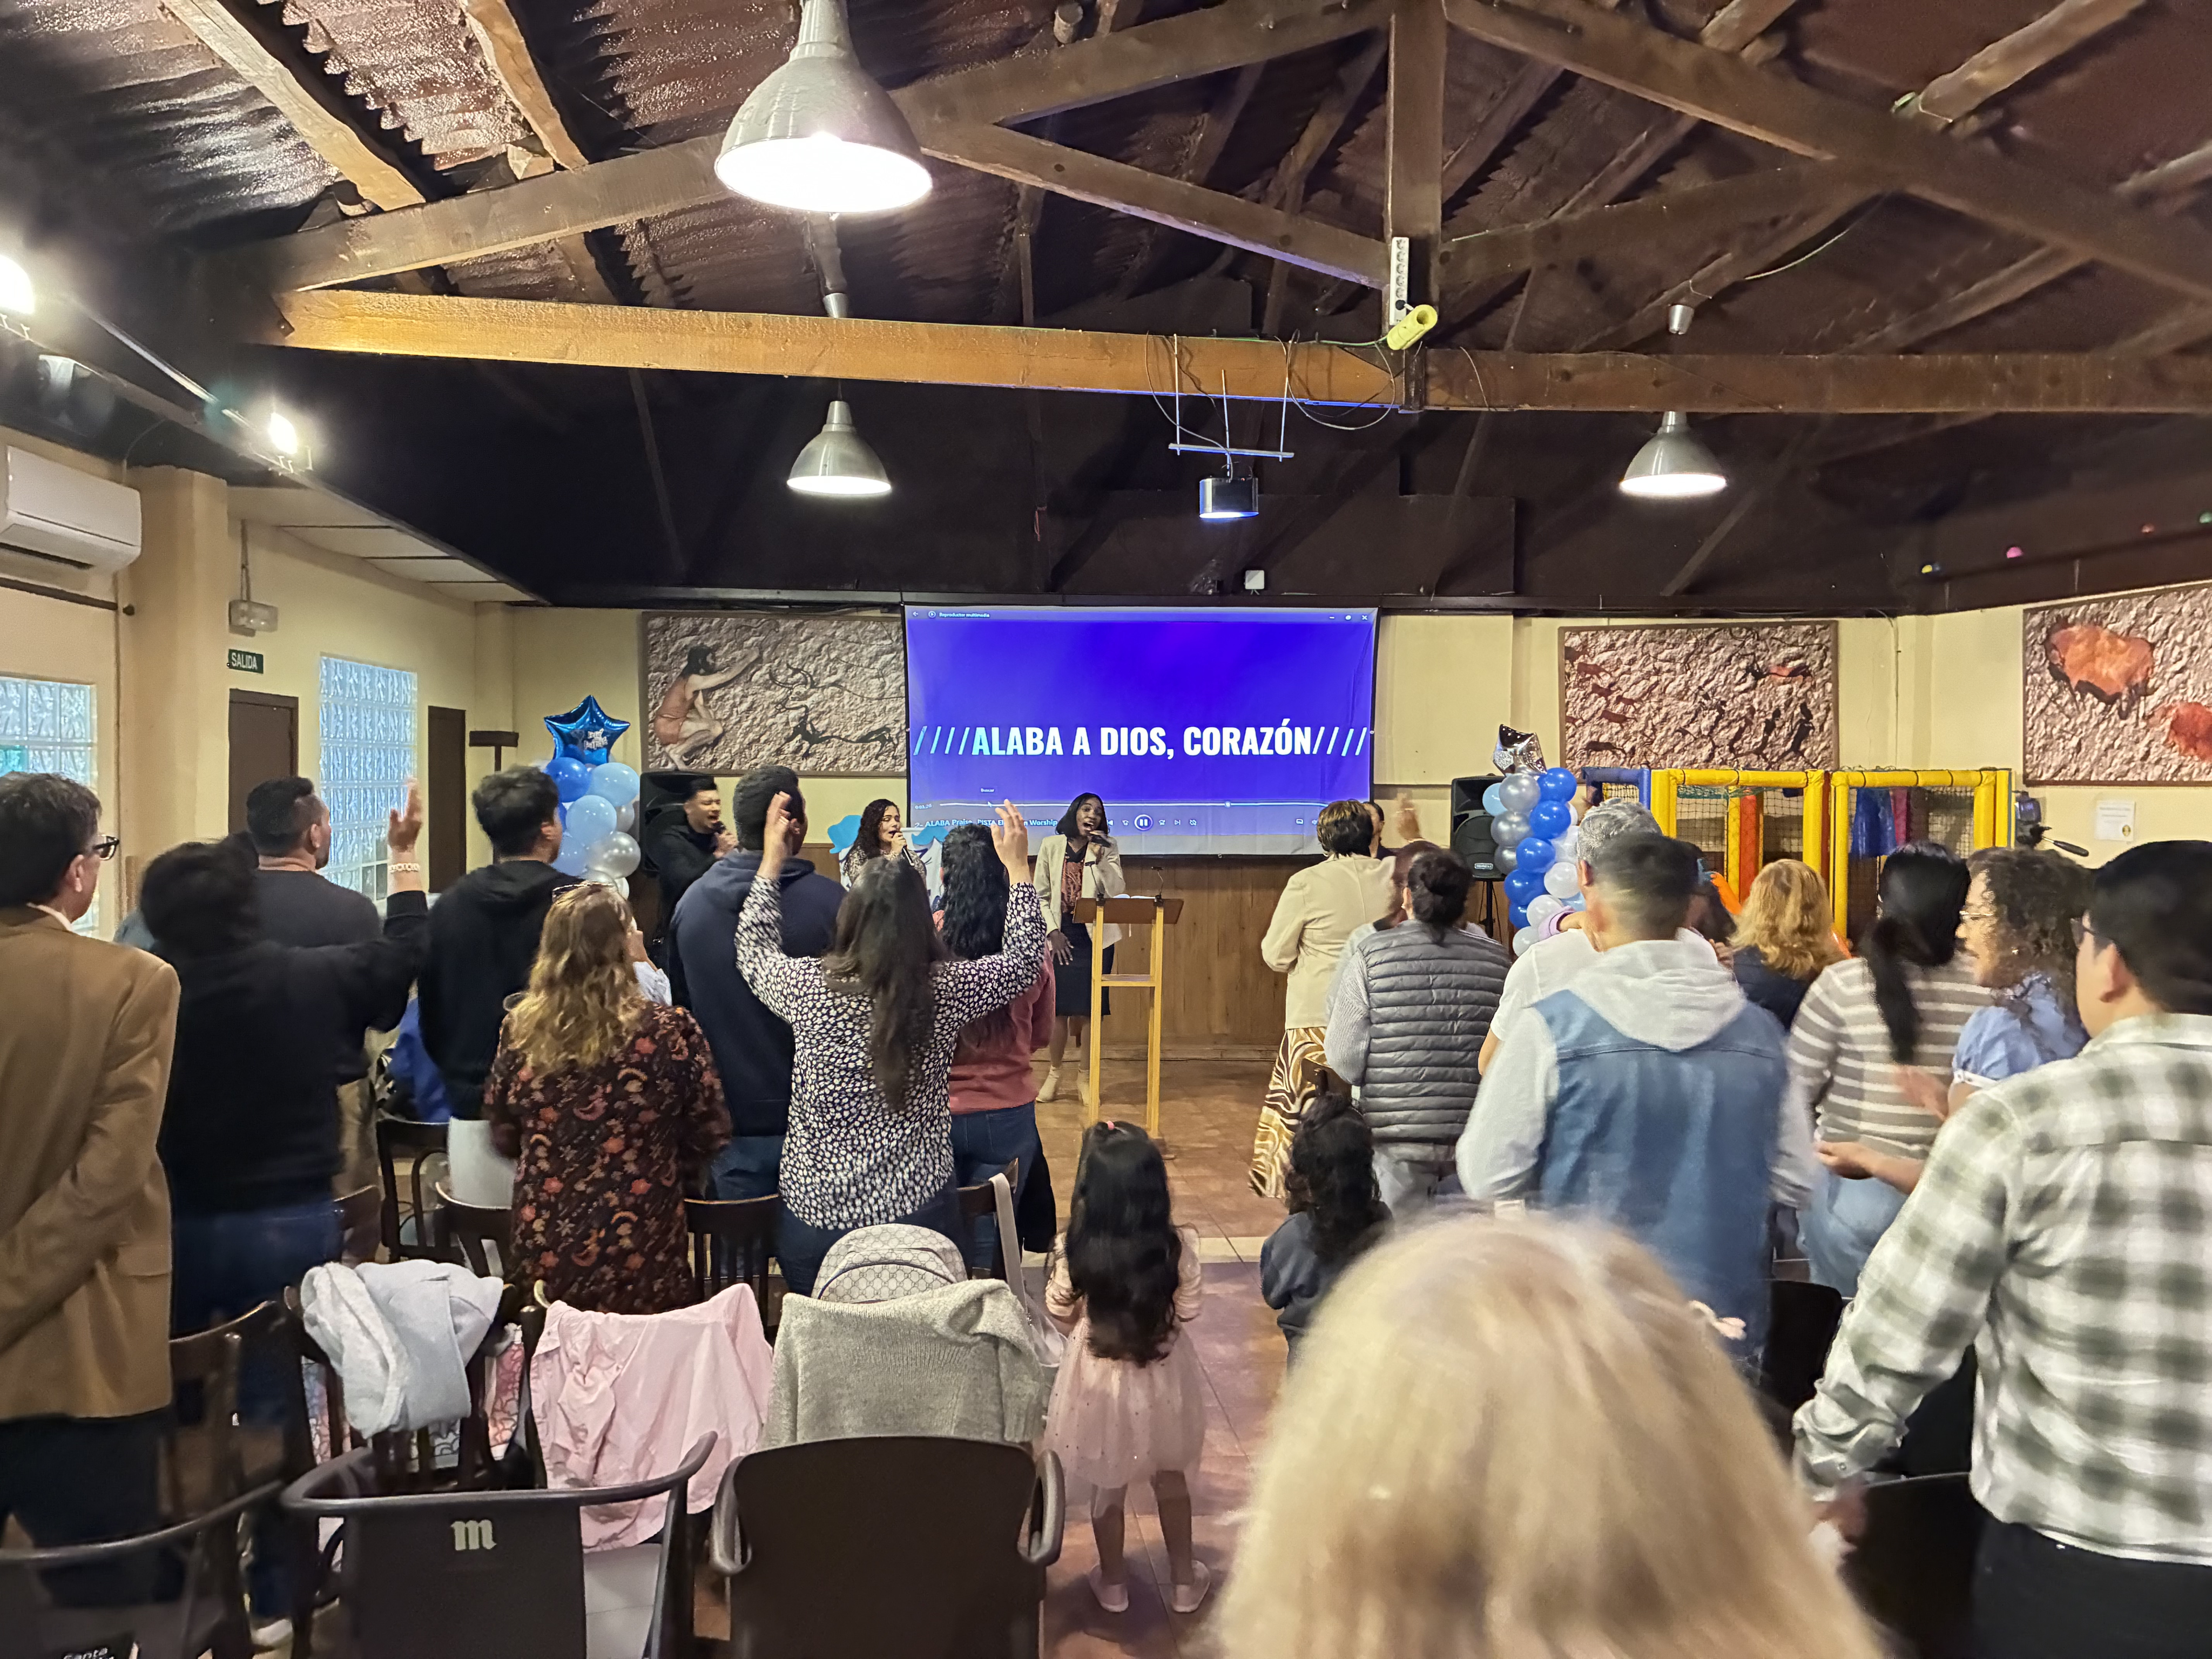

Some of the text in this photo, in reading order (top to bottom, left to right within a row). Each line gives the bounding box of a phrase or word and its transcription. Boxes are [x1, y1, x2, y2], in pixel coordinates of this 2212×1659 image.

[231, 652, 258, 670] SALIDA
[1073, 726, 1091, 756] A
[1101, 727, 1174, 760] DIOS,
[1029, 819, 1058, 827] Worship
